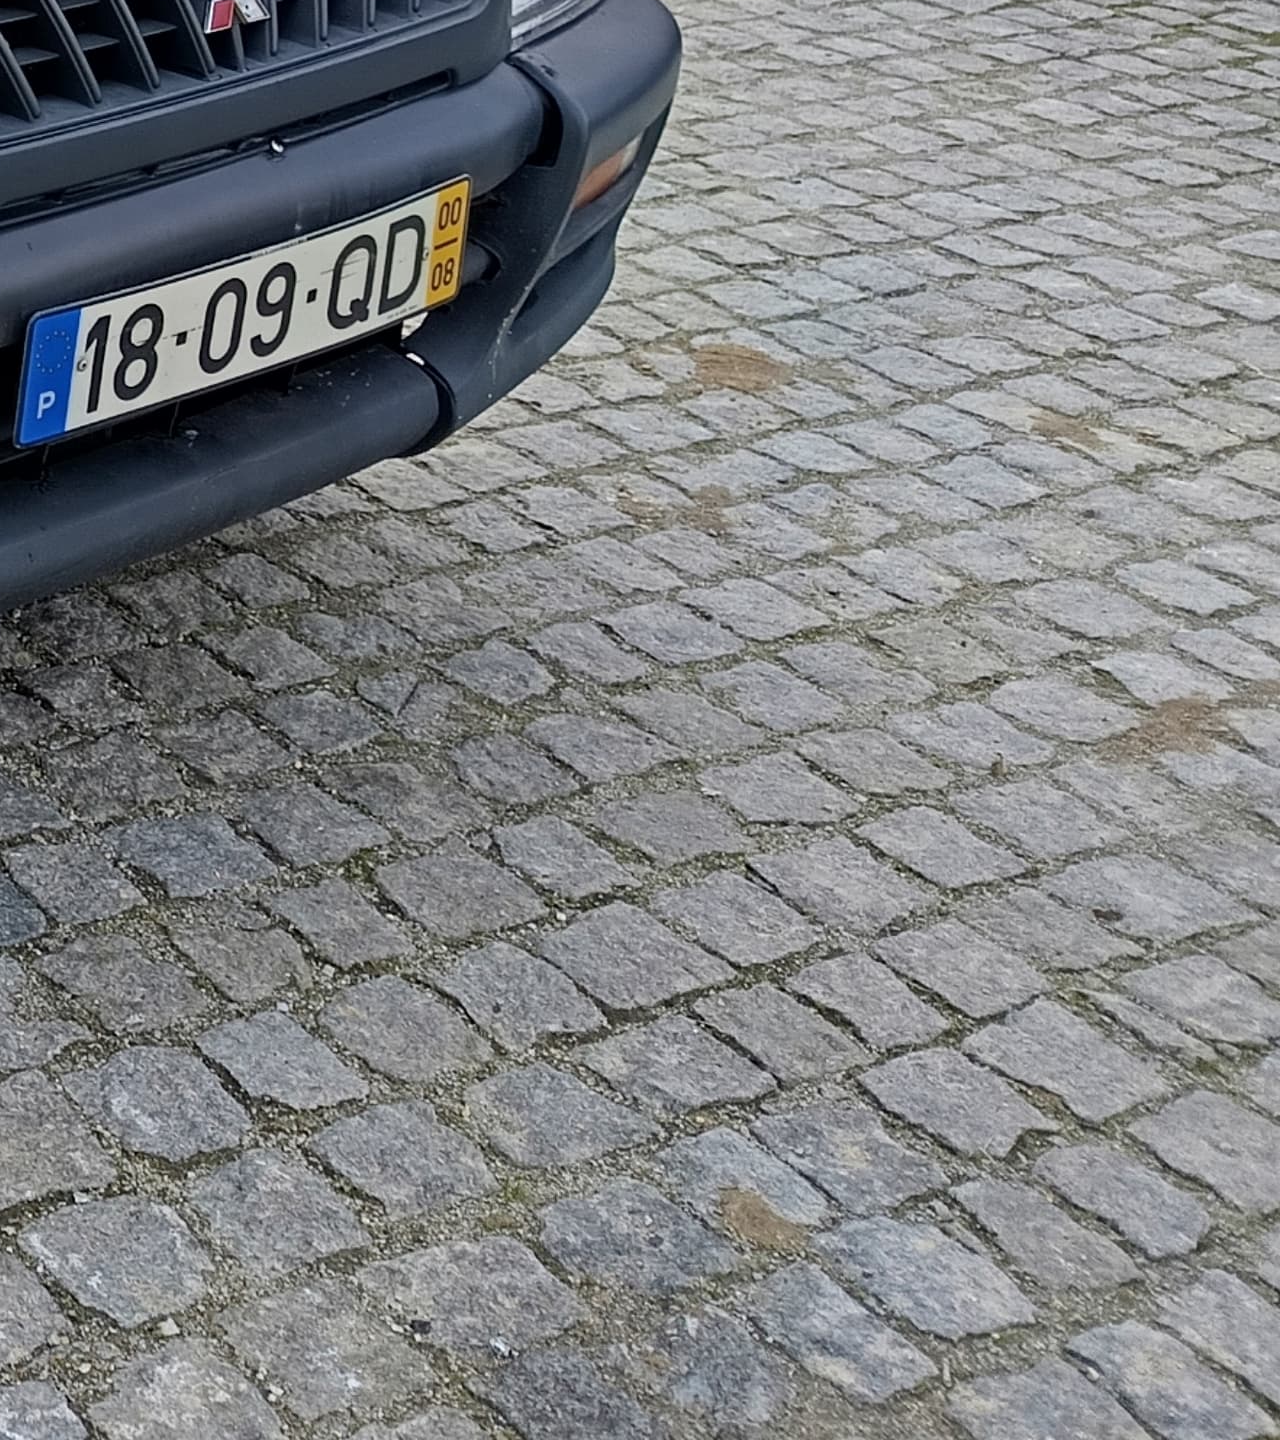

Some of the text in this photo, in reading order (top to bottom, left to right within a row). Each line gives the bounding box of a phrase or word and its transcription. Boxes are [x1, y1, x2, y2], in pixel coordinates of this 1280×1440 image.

[438, 197, 462, 230] 00
[431, 257, 455, 291] 08
[37, 390, 56, 420] P
